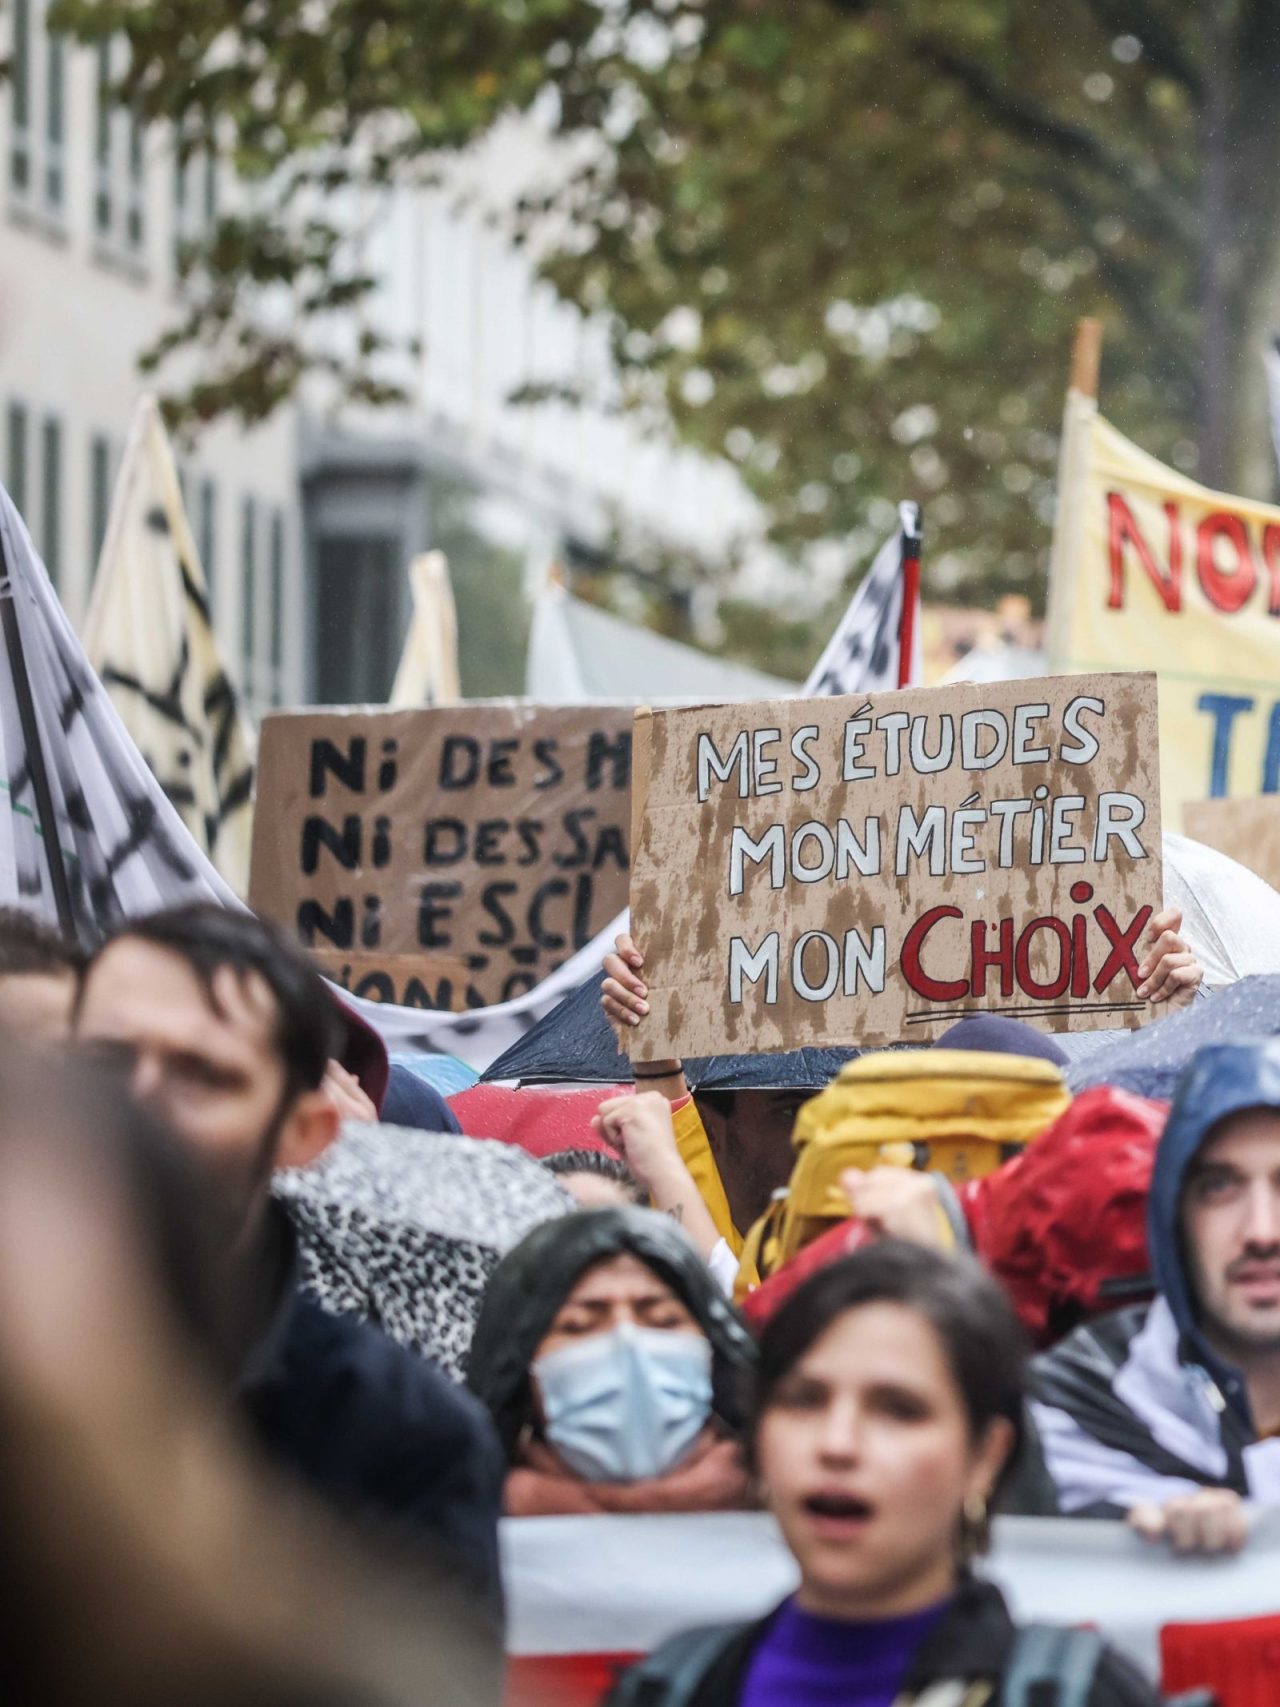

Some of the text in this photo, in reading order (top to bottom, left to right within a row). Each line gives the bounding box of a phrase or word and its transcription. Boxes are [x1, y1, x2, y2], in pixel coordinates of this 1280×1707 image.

[438, 733, 564, 791] DES
[697, 695, 1105, 802] MES ÉTUDES
[423, 816, 545, 868] DES
[729, 815, 882, 896] MON
[729, 925, 887, 1004] MON
